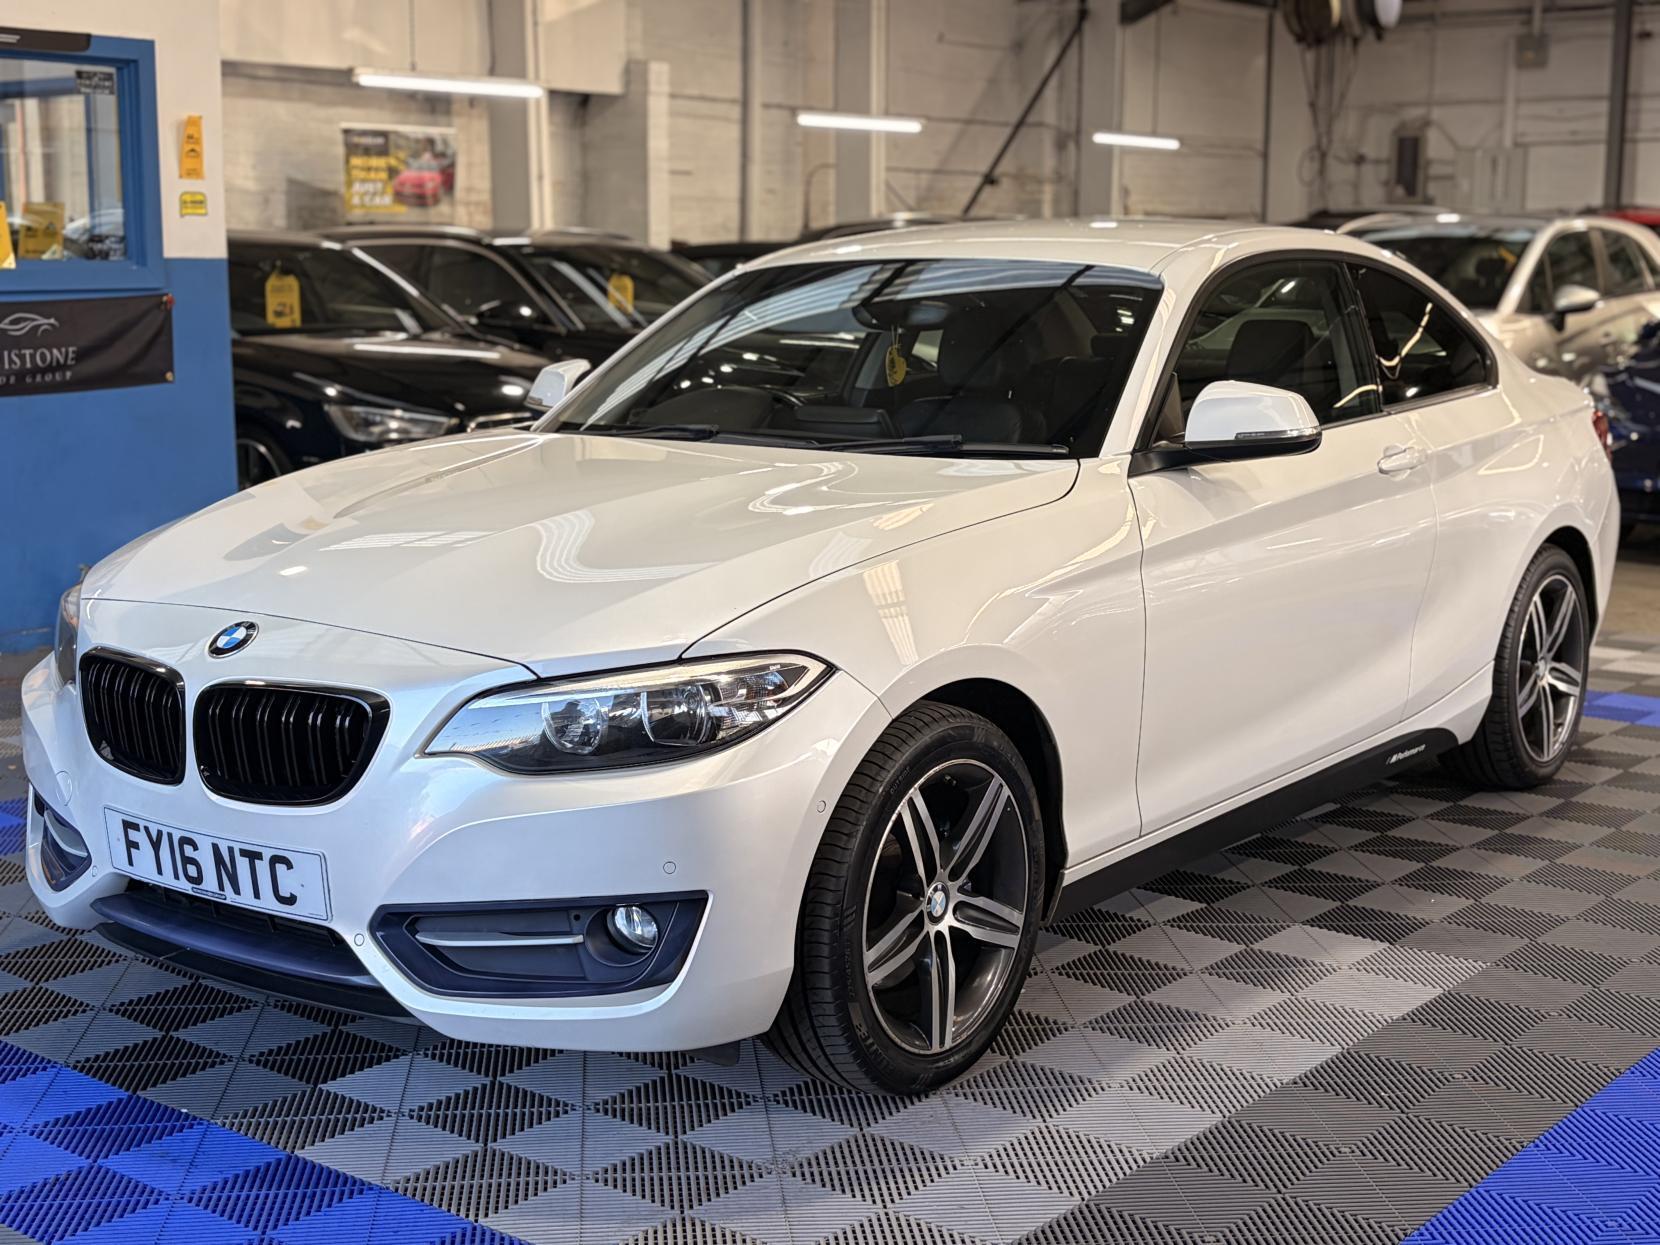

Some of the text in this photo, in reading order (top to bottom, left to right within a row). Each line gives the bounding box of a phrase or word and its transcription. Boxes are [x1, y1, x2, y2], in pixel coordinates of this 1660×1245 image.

[25, 371, 73, 384] GROUP
[121, 818, 298, 906] FY16 NTC
